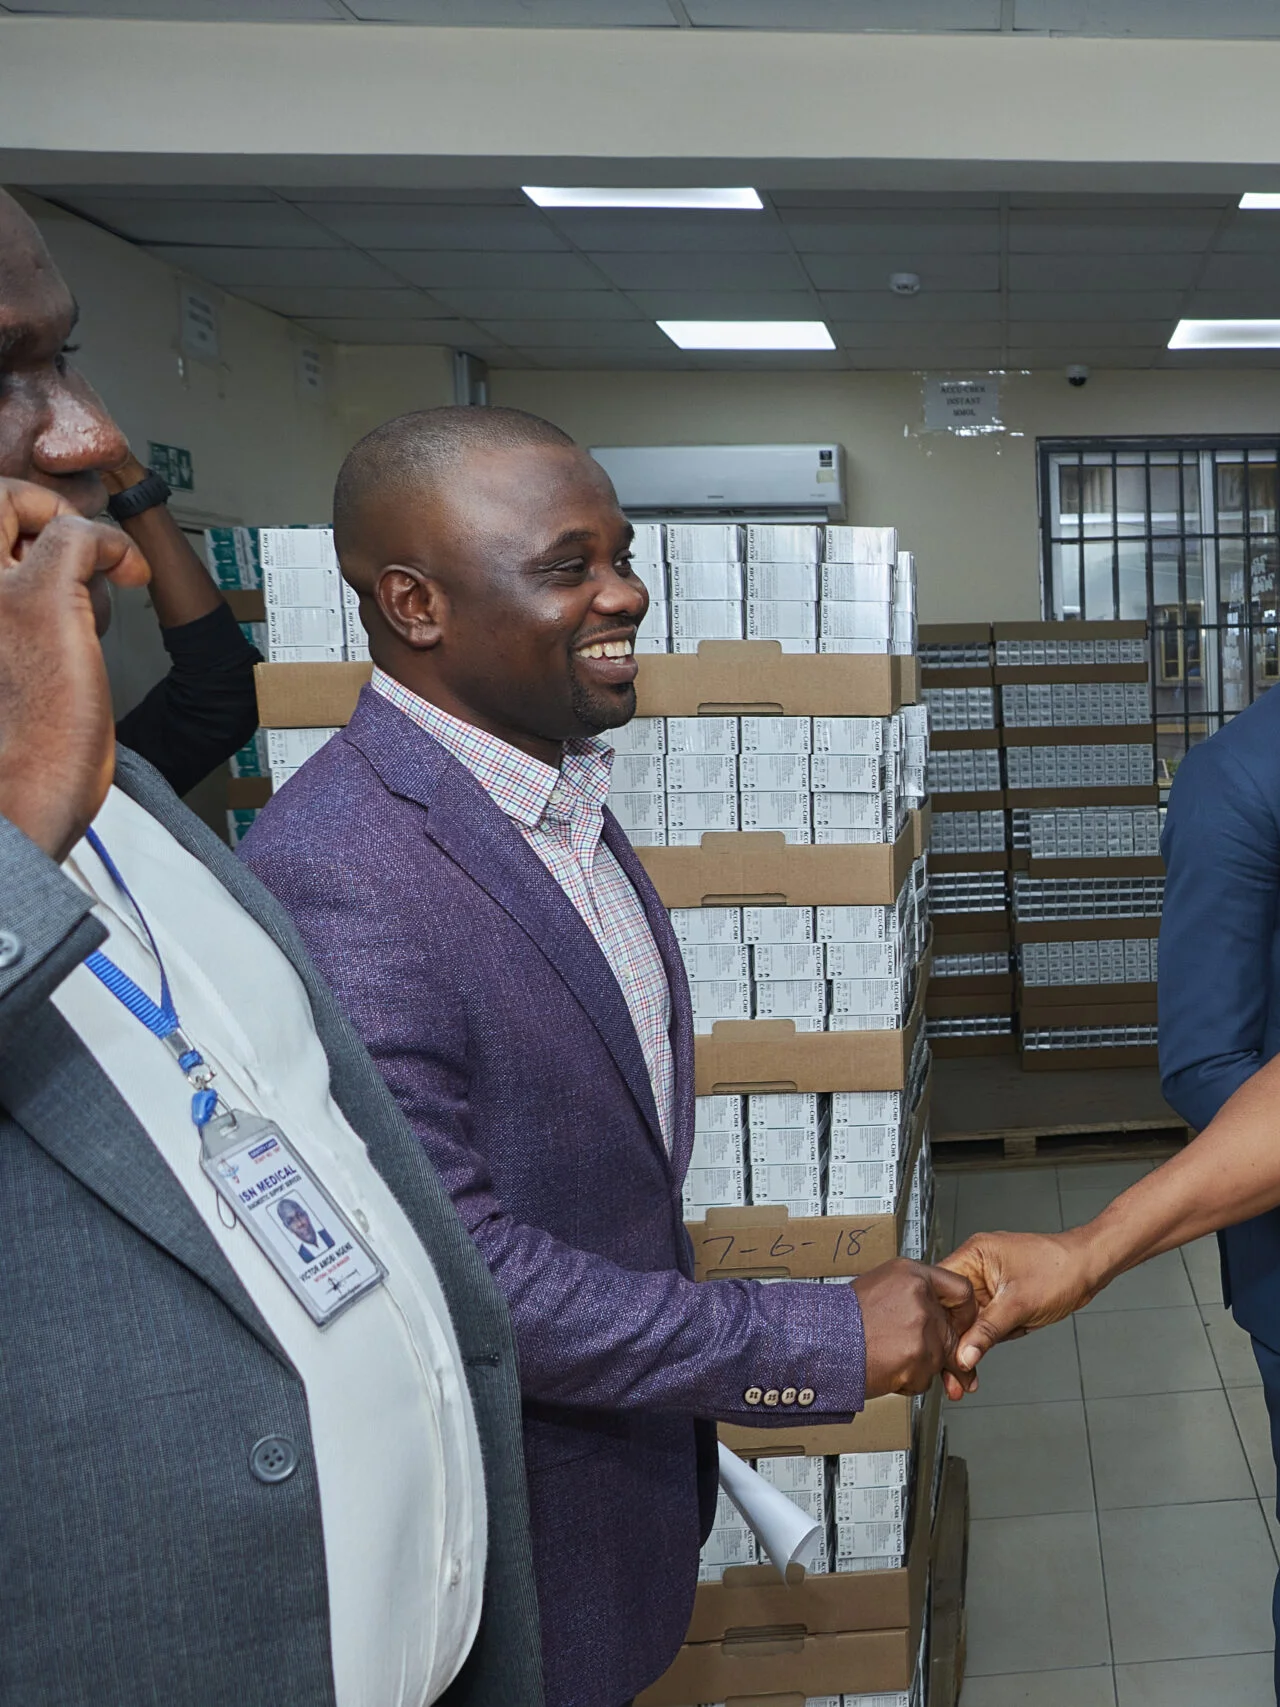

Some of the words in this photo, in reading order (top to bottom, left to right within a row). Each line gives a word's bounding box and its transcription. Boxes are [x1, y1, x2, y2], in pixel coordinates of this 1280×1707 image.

[239, 1187, 258, 1203] ISN
[256, 1164, 297, 1193] MEDICAL
[300, 1265, 320, 1282] VICTOR
